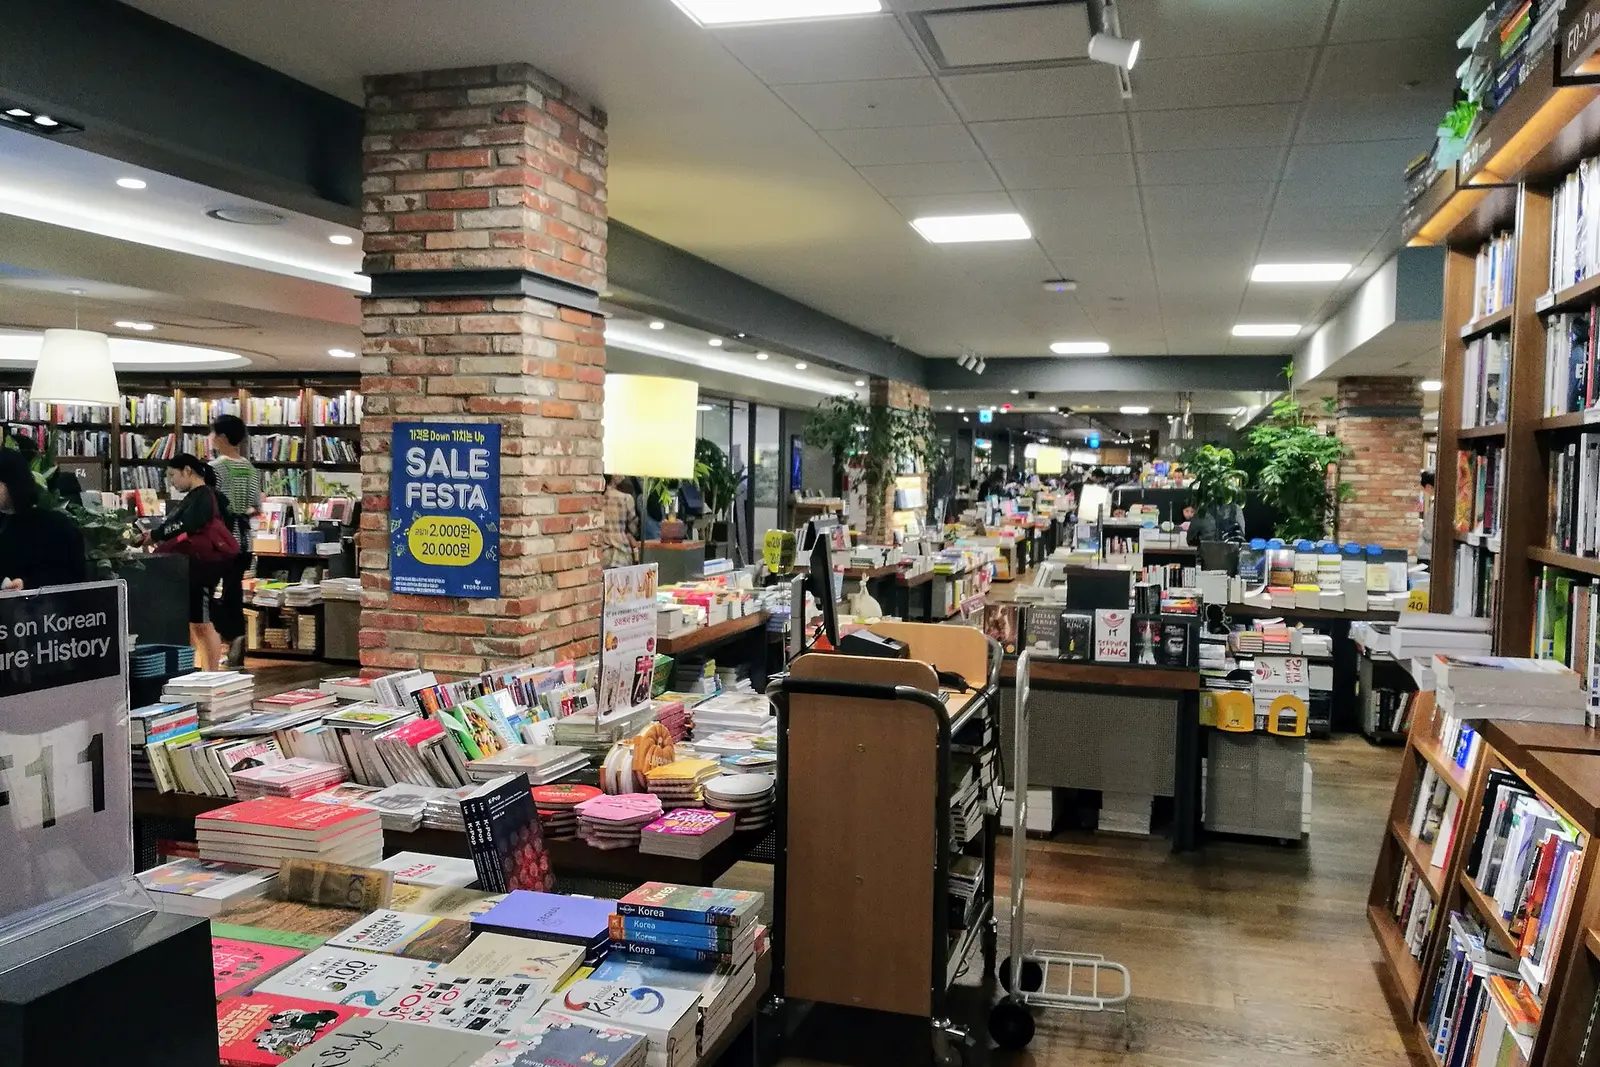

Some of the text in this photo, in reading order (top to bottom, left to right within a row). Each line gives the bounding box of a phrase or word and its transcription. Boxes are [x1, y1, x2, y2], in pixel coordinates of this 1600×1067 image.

[409, 429, 485, 445] 가격은 Down 가치는 Up
[406, 447, 489, 479] SALE
[75, 468, 87, 478] F4
[405, 482, 489, 510] FESTA
[14, 621, 38, 638] on
[44, 611, 107, 634] Korean
[1099, 647, 1127, 657] KING
[0, 733, 105, 828] 11
[638, 906, 665, 918] Korea
[346, 914, 397, 943] CAMPING
[634, 920, 656, 929] Korea
[635, 932, 657, 941] Korea
[629, 944, 655, 955] Korea
[324, 960, 367, 980] 100
[348, 963, 378, 982] mots
[378, 979, 438, 1021] Seoul
[583, 986, 633, 1017] Korea
[589, 984, 616, 1002] Inside
[504, 995, 525, 1013] Korea
